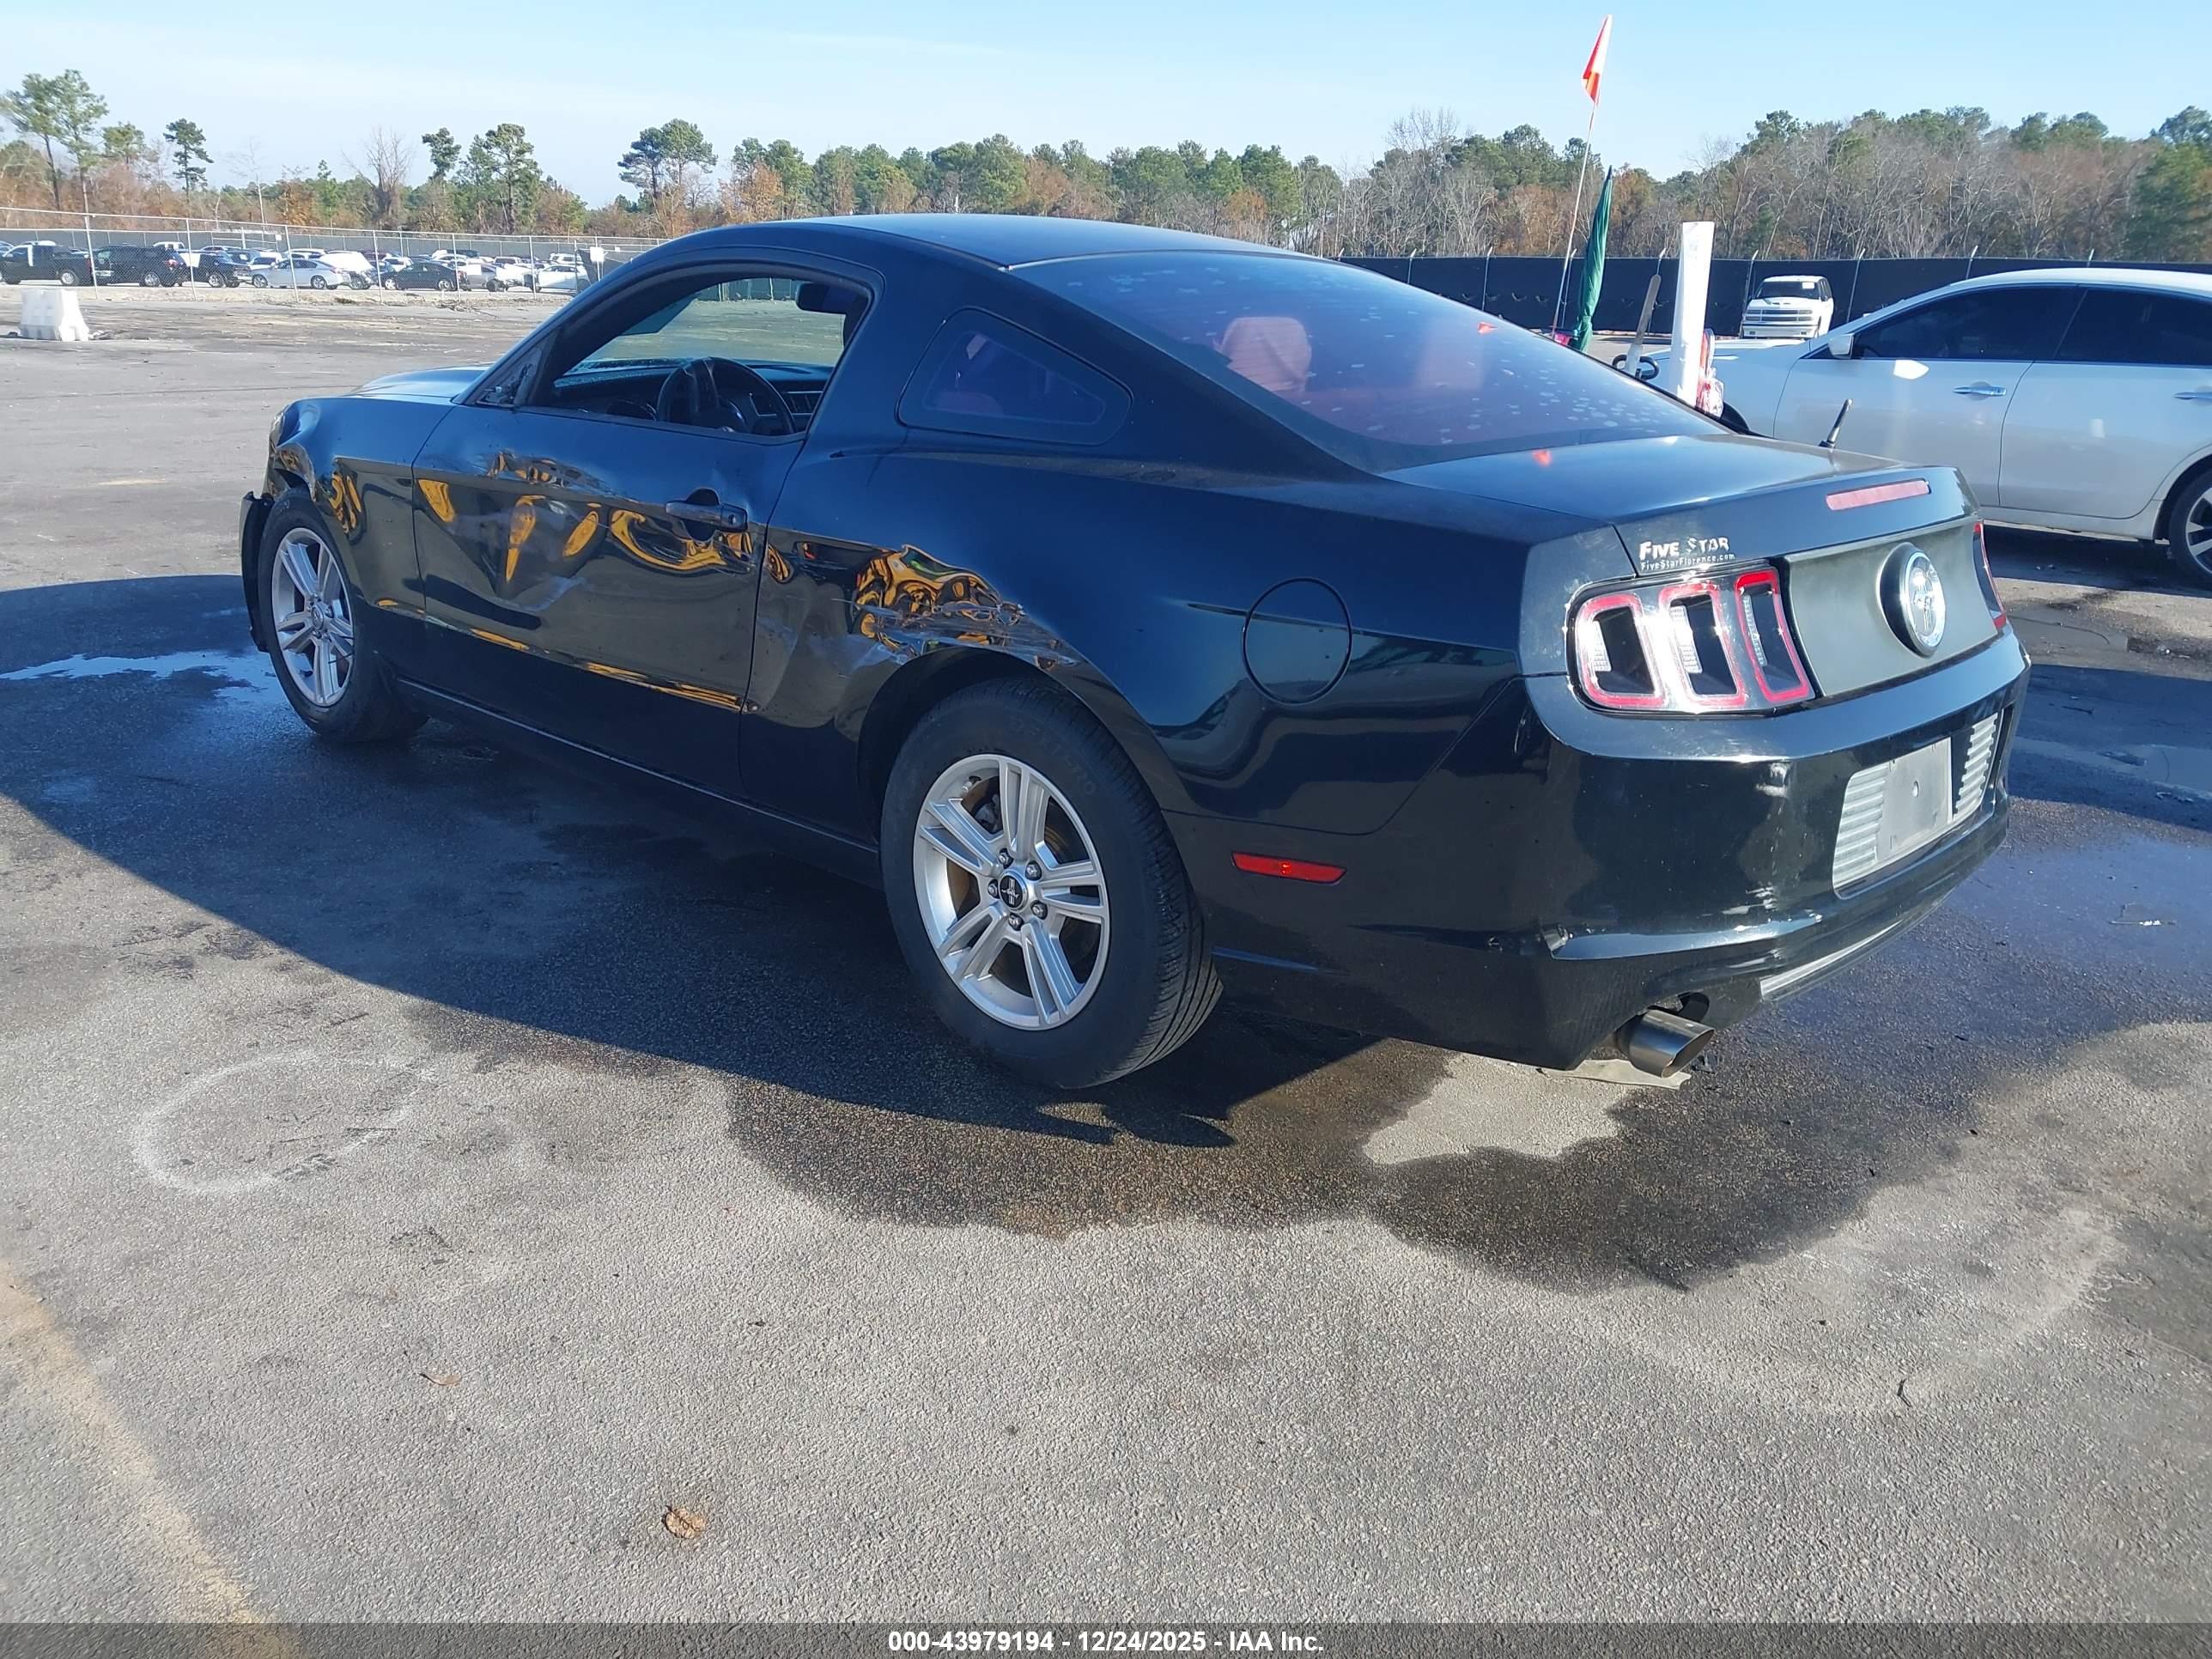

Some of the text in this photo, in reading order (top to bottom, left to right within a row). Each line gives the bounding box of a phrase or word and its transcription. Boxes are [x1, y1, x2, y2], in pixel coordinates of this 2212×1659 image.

[1639, 537, 1729, 560] FIVE STAR
[1640, 553, 1735, 570] FiveStarFlorence.com
